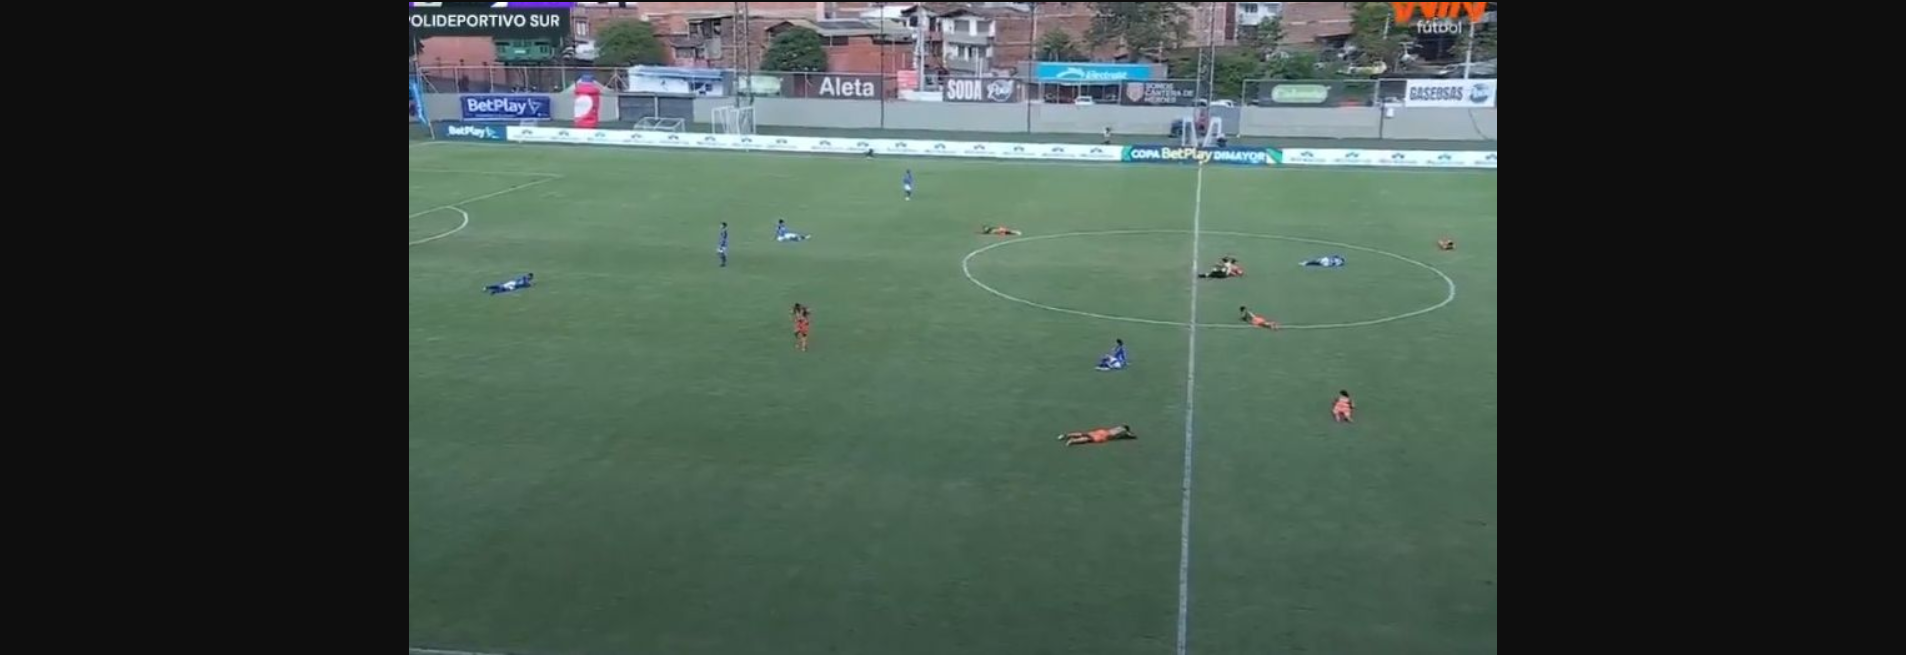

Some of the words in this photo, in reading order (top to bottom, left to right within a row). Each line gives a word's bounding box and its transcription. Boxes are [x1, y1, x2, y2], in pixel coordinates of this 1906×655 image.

[819, 76, 875, 97] Aleta
[947, 79, 982, 100] SODA
[1410, 86, 1463, 101] GASEOSAS
[467, 97, 526, 115] BetPlay
[448, 125, 485, 139] BetPlay
[1131, 150, 1160, 159] COPA
[1161, 147, 1212, 162] BetPlay
[1213, 151, 1266, 160] DIMAYOR
